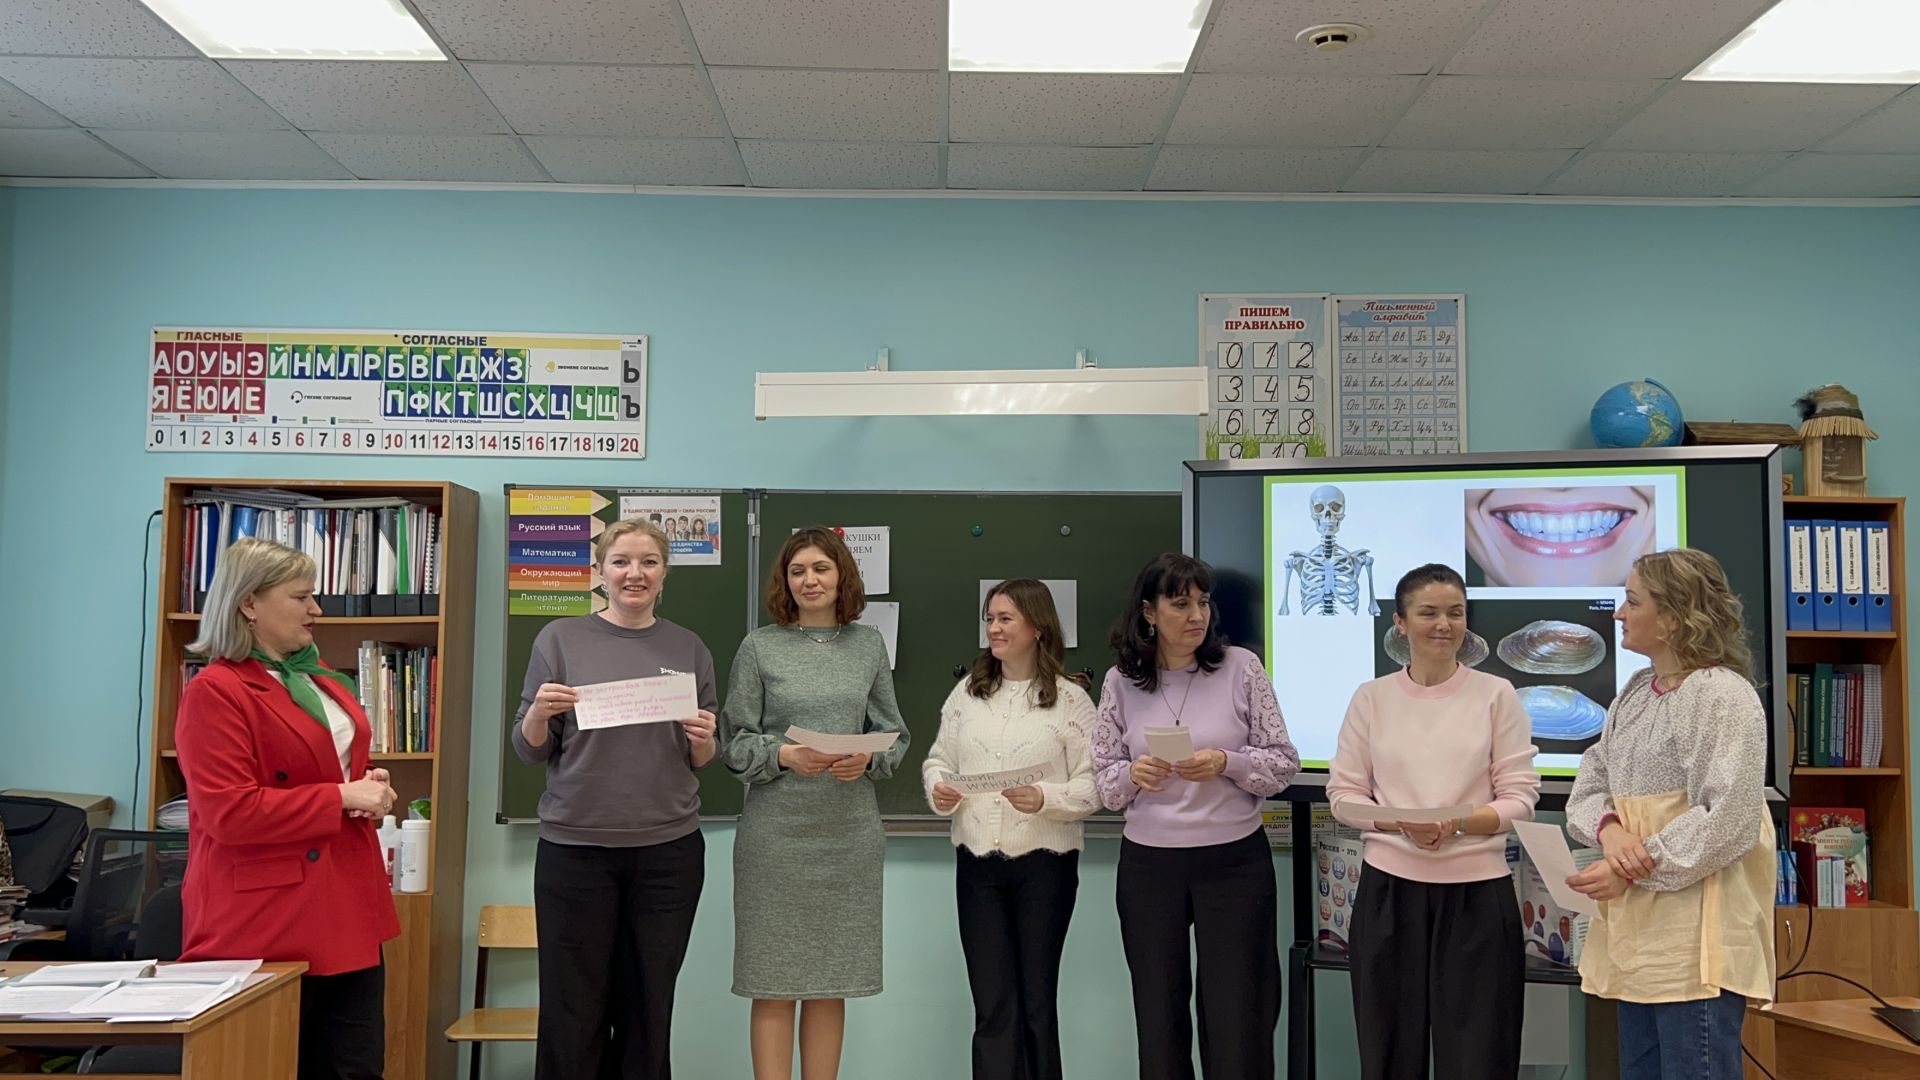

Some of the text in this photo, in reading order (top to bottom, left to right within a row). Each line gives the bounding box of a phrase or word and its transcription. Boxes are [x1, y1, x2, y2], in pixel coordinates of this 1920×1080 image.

[1363, 301, 1436, 311] Письменный
[1239, 307, 1290, 317] ПИШЕМ
[1373, 313, 1425, 323] алфавит
[1224, 320, 1305, 330] ПРАВИЛЬНО
[176, 331, 243, 341] ГЛАСНЫЕ
[402, 335, 487, 346] СОГЛАСНЫЕ
[1226, 342, 1314, 368] 0 1 2
[1225, 375, 1314, 402] 3 4 5
[1226, 408, 1314, 435] 6 7 8
[155, 429, 639, 453] 0 1 2 3 4 5 6 7 8 9 10 11 12 13 14 15 16 17 18 19 20
[528, 493, 575, 502] Домашнее
[518, 523, 555, 533] Русский
[843, 534, 880, 542] КУШКИ
[522, 548, 577, 558] Математика
[520, 568, 582, 578] Окружающий
[542, 580, 560, 588] мир
[520, 593, 584, 602] Литературное
